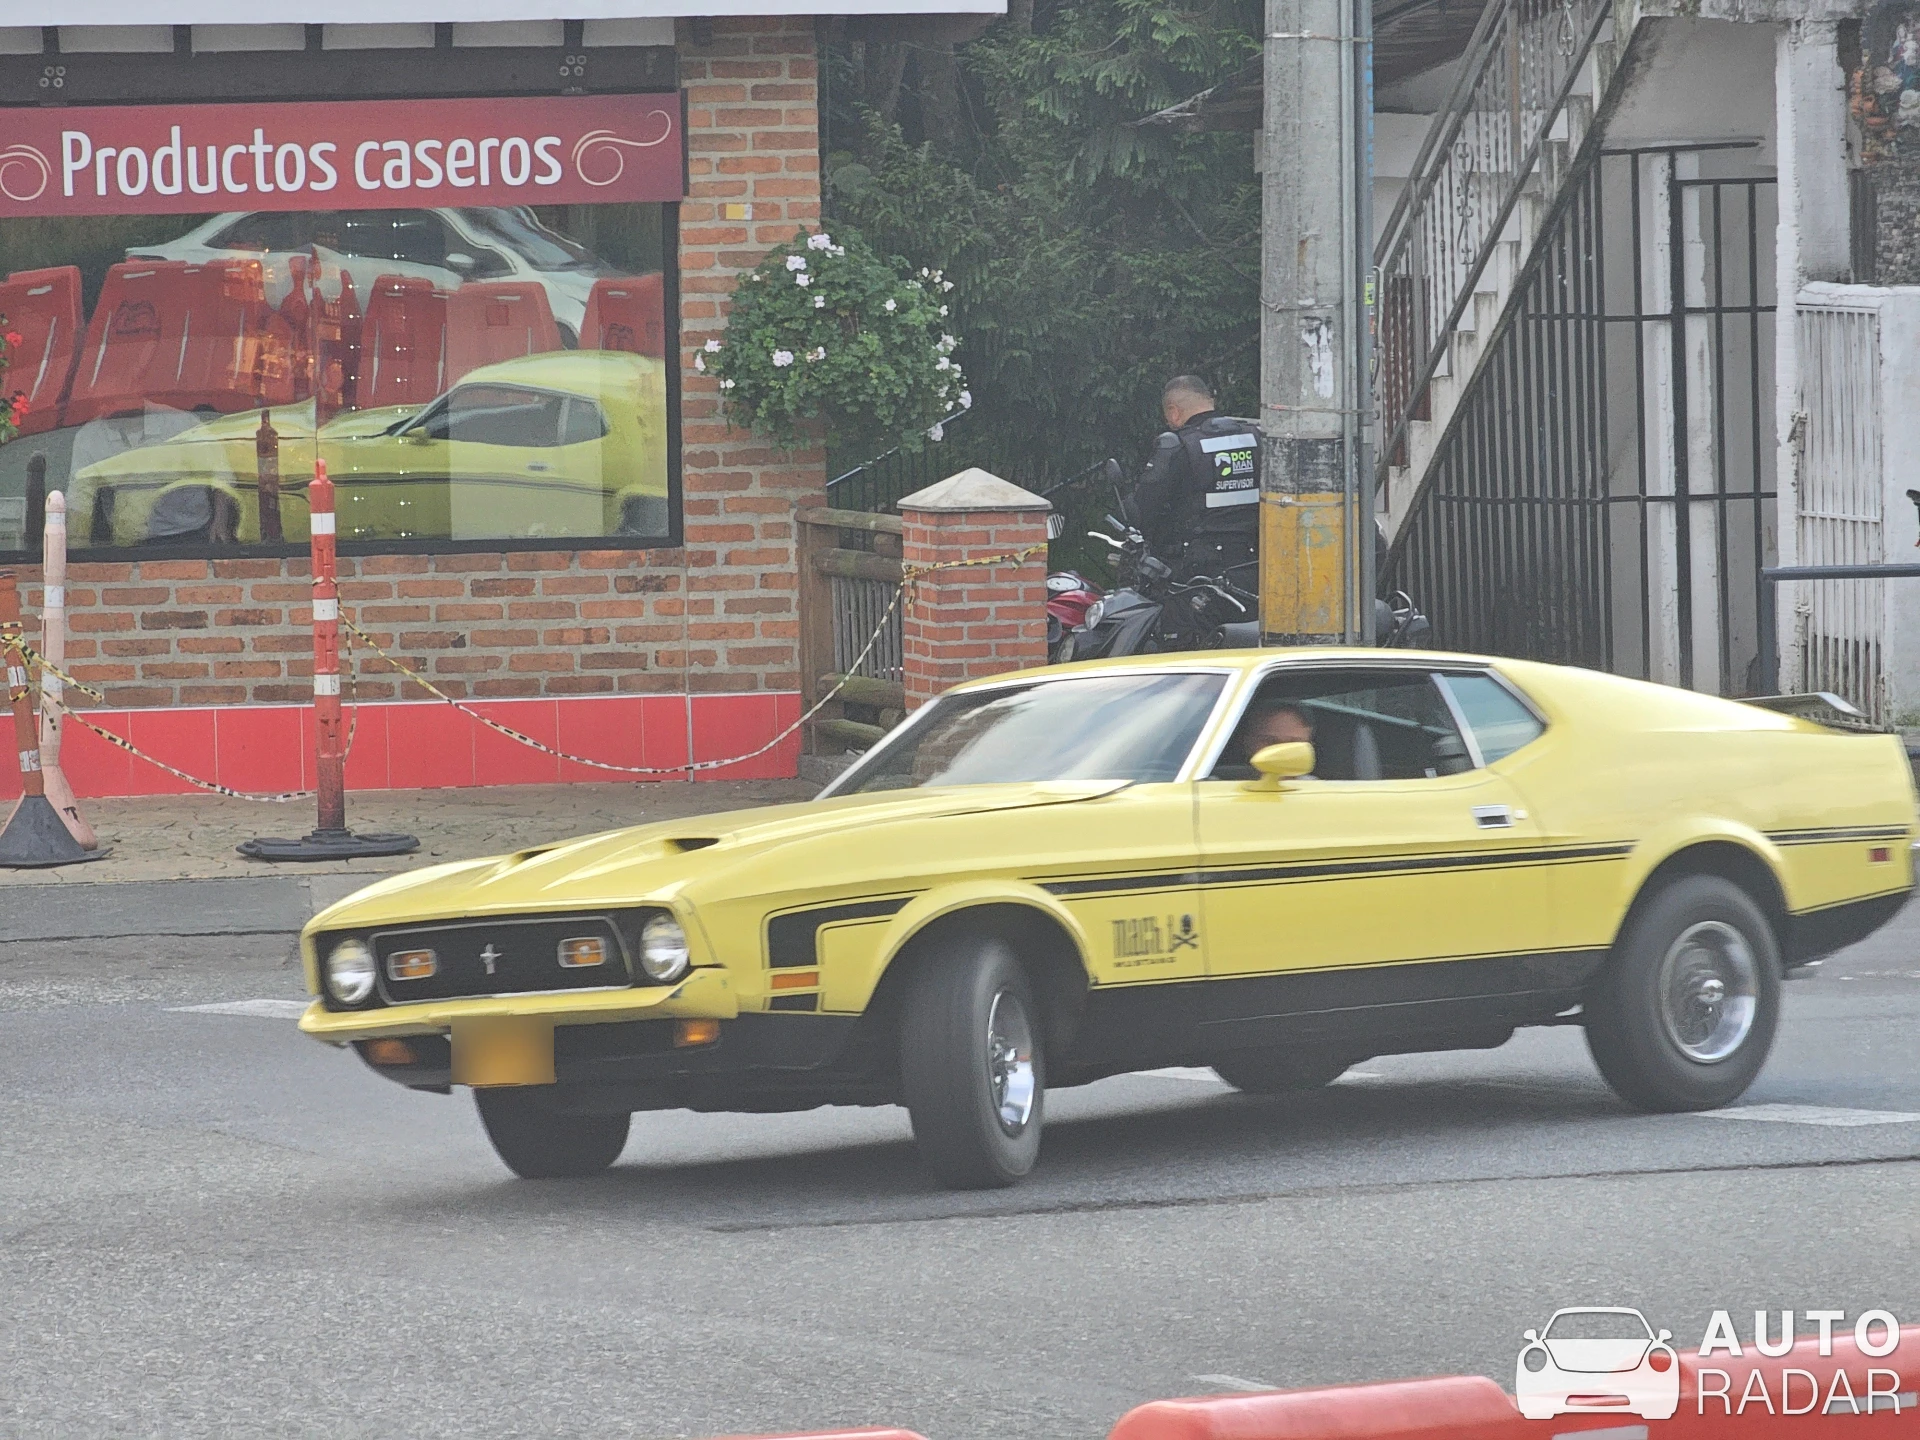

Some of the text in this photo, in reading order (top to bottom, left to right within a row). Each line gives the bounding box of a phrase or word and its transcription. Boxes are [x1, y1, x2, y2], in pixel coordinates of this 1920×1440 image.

[61, 125, 562, 197] Productos caseros
[1232, 460, 1253, 470] MAN
[1215, 478, 1254, 490] SUPERVISOR
